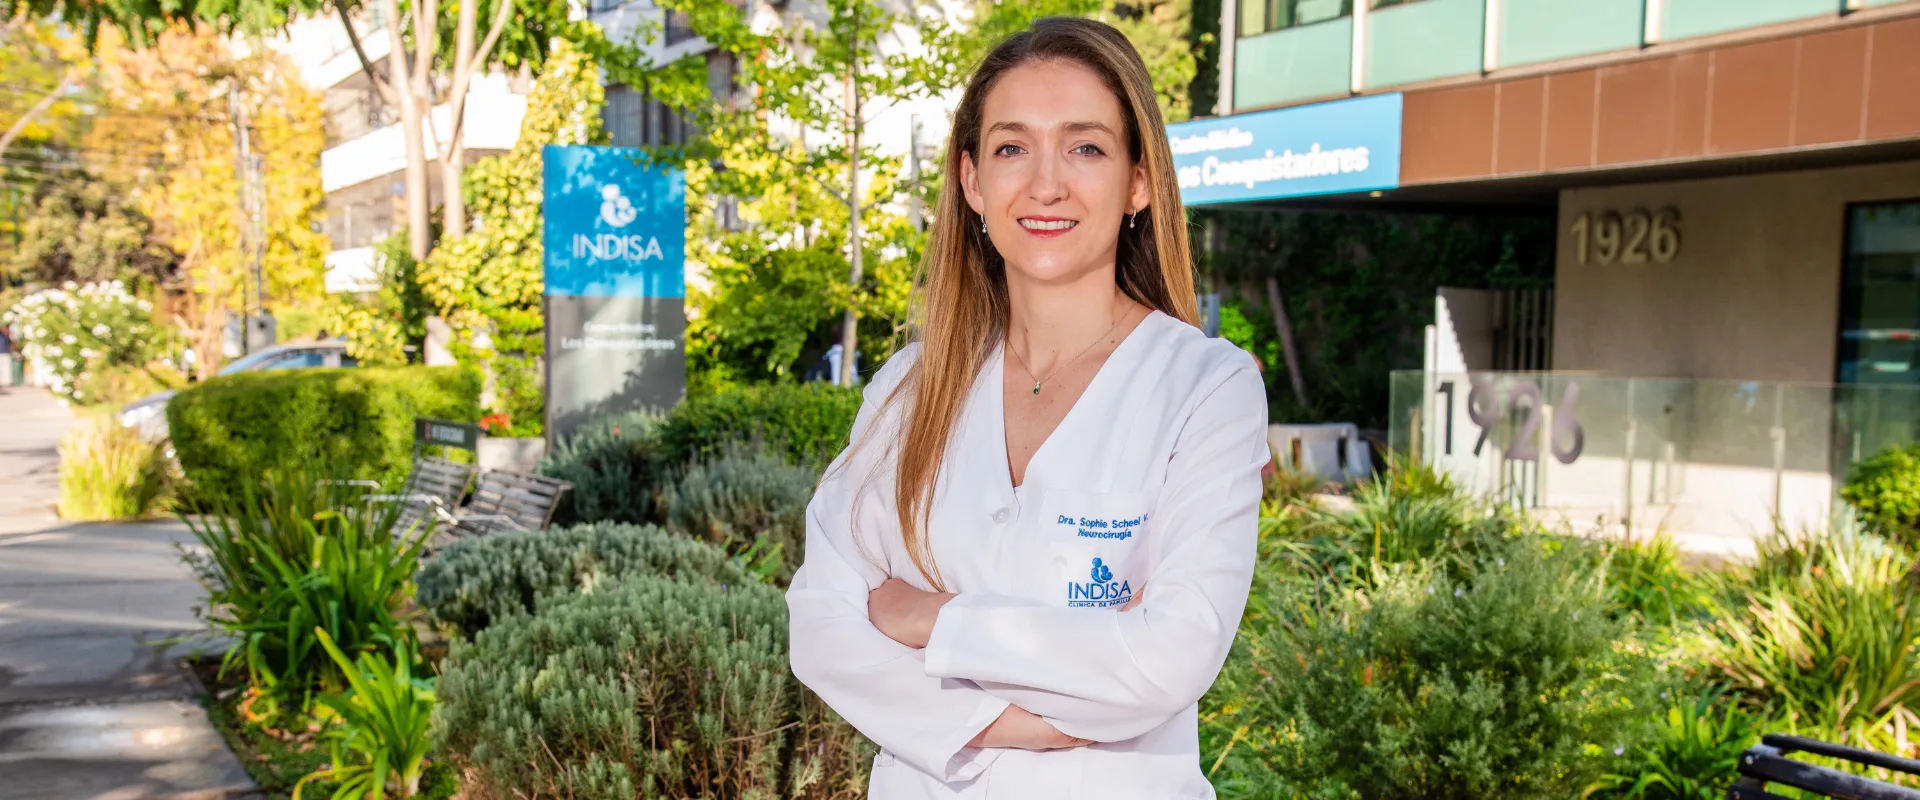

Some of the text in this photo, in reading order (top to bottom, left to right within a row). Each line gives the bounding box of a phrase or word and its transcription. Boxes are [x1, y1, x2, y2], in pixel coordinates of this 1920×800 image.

[1177, 142, 1369, 189] os Conquistadores
[572, 233, 664, 261] INDISA
[1569, 205, 1681, 265] 1926
[1436, 380, 1584, 464] 1926
[1057, 514, 1076, 526] Dra.
[1080, 517, 1108, 529] Sophie
[1112, 516, 1141, 529] Scheel
[1077, 528, 1132, 540] Neurocirugía
[1068, 580, 1132, 599] INDISA
